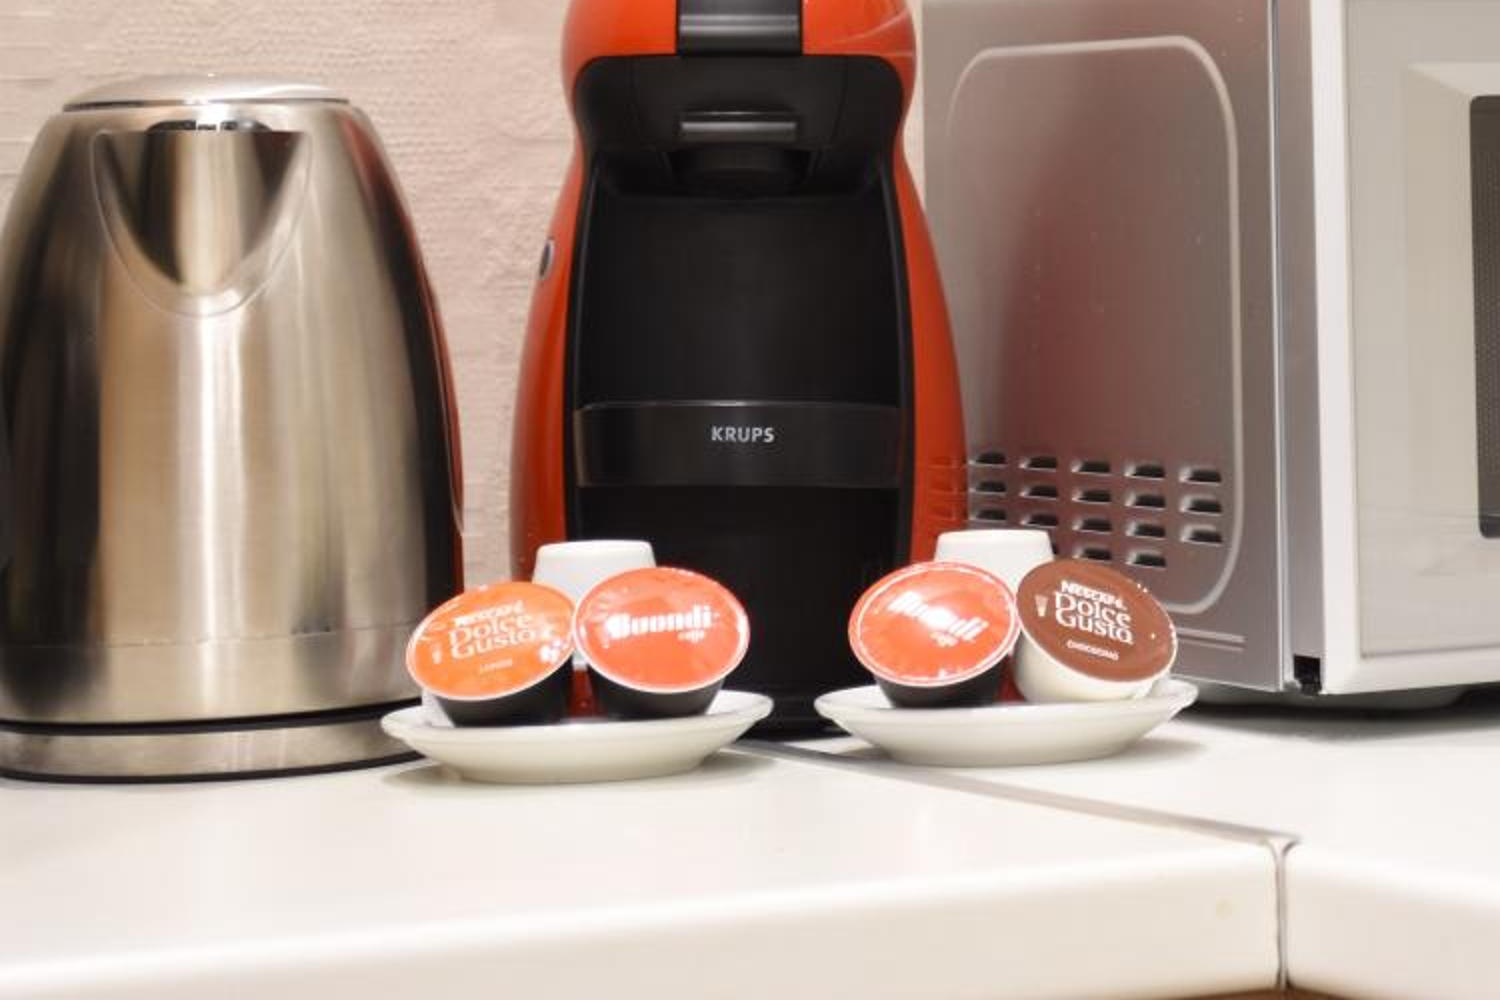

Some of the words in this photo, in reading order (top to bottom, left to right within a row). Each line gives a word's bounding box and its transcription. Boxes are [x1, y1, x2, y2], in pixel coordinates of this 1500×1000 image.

[711, 426, 776, 443] KRUPS
[1054, 591, 1132, 629] Dolce
[449, 614, 533, 644] Dolce
[1055, 609, 1135, 646] Gusto
[450, 628, 537, 660] Gusto
